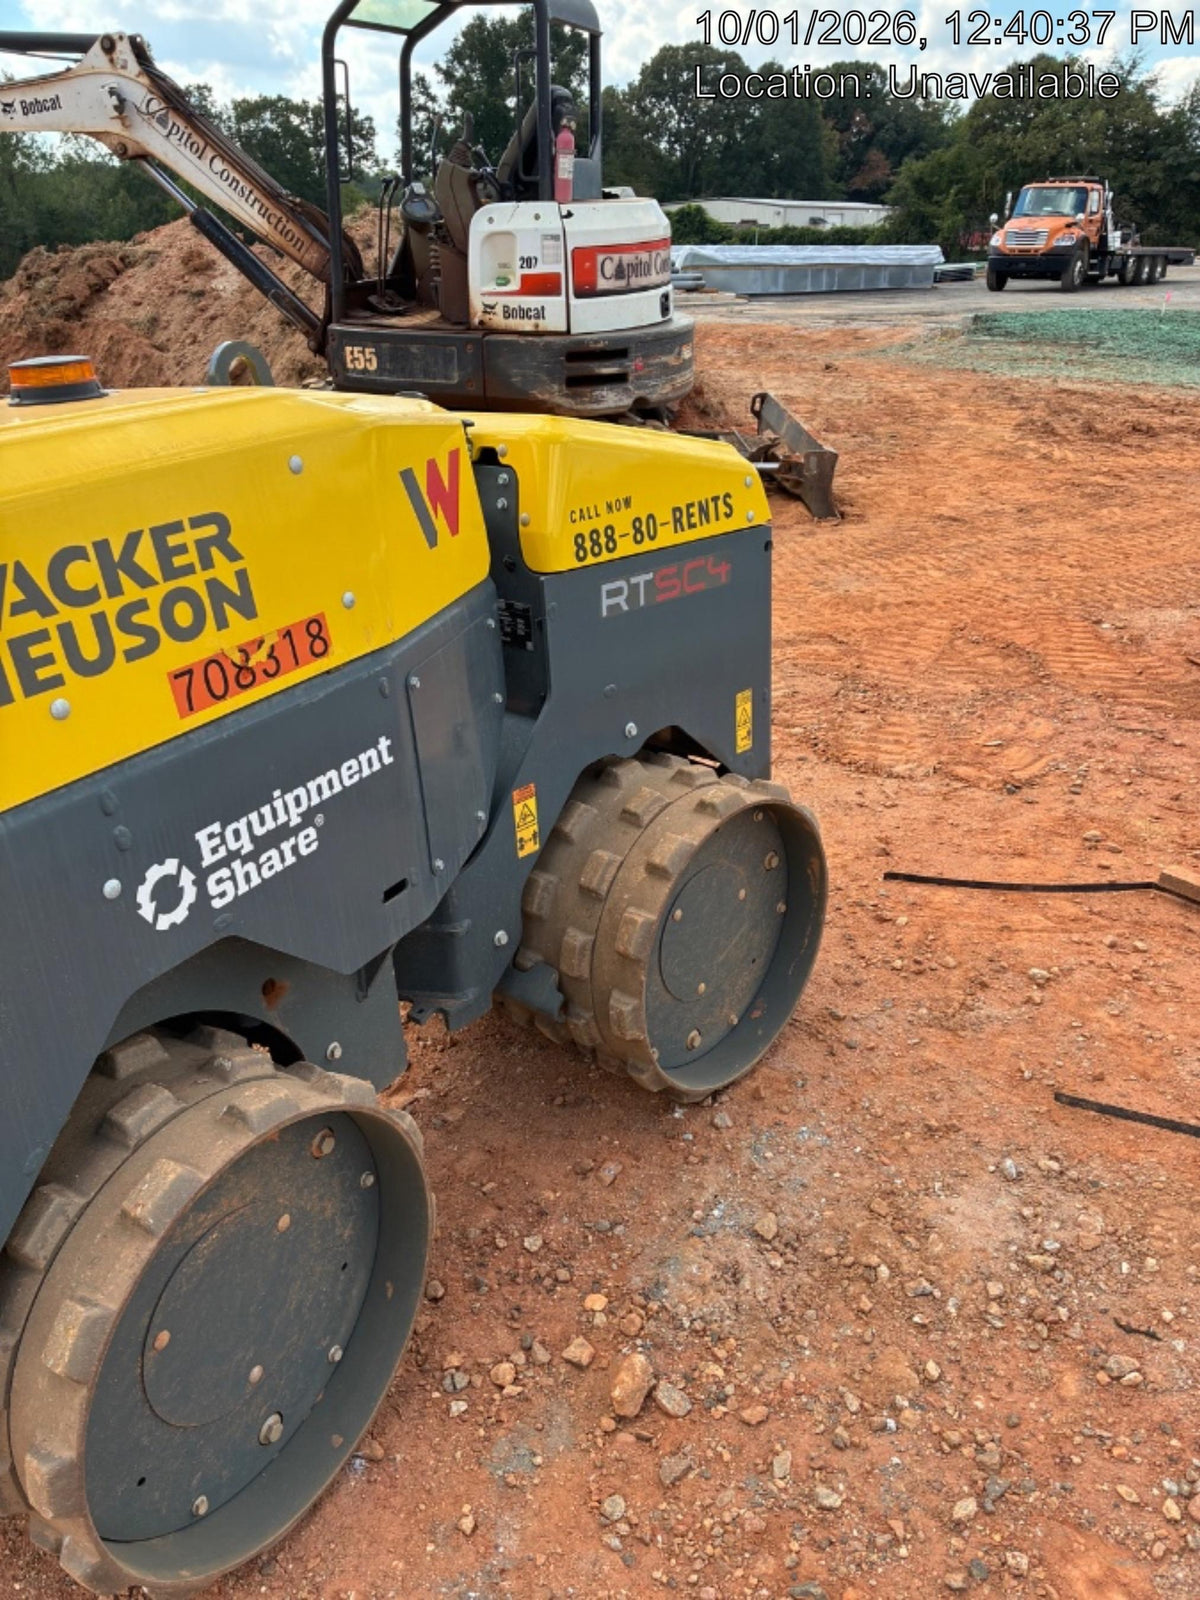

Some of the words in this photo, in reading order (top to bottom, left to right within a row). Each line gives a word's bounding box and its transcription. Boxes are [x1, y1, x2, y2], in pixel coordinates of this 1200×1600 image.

[20, 94, 63, 117] Bobcat
[208, 153, 308, 253] Construction
[518, 255, 539, 270] 207
[502, 304, 546, 321] Bobcat
[343, 345, 378, 371] E55
[569, 504, 602, 524] CALL
[605, 495, 633, 515] NOW
[573, 491, 735, 563] 888-80-RENTS
[0, 511, 245, 632] ACKER
[601, 555, 732, 618] RTSC4
[172, 617, 329, 712] 708318
[194, 735, 394, 869] Equipment
